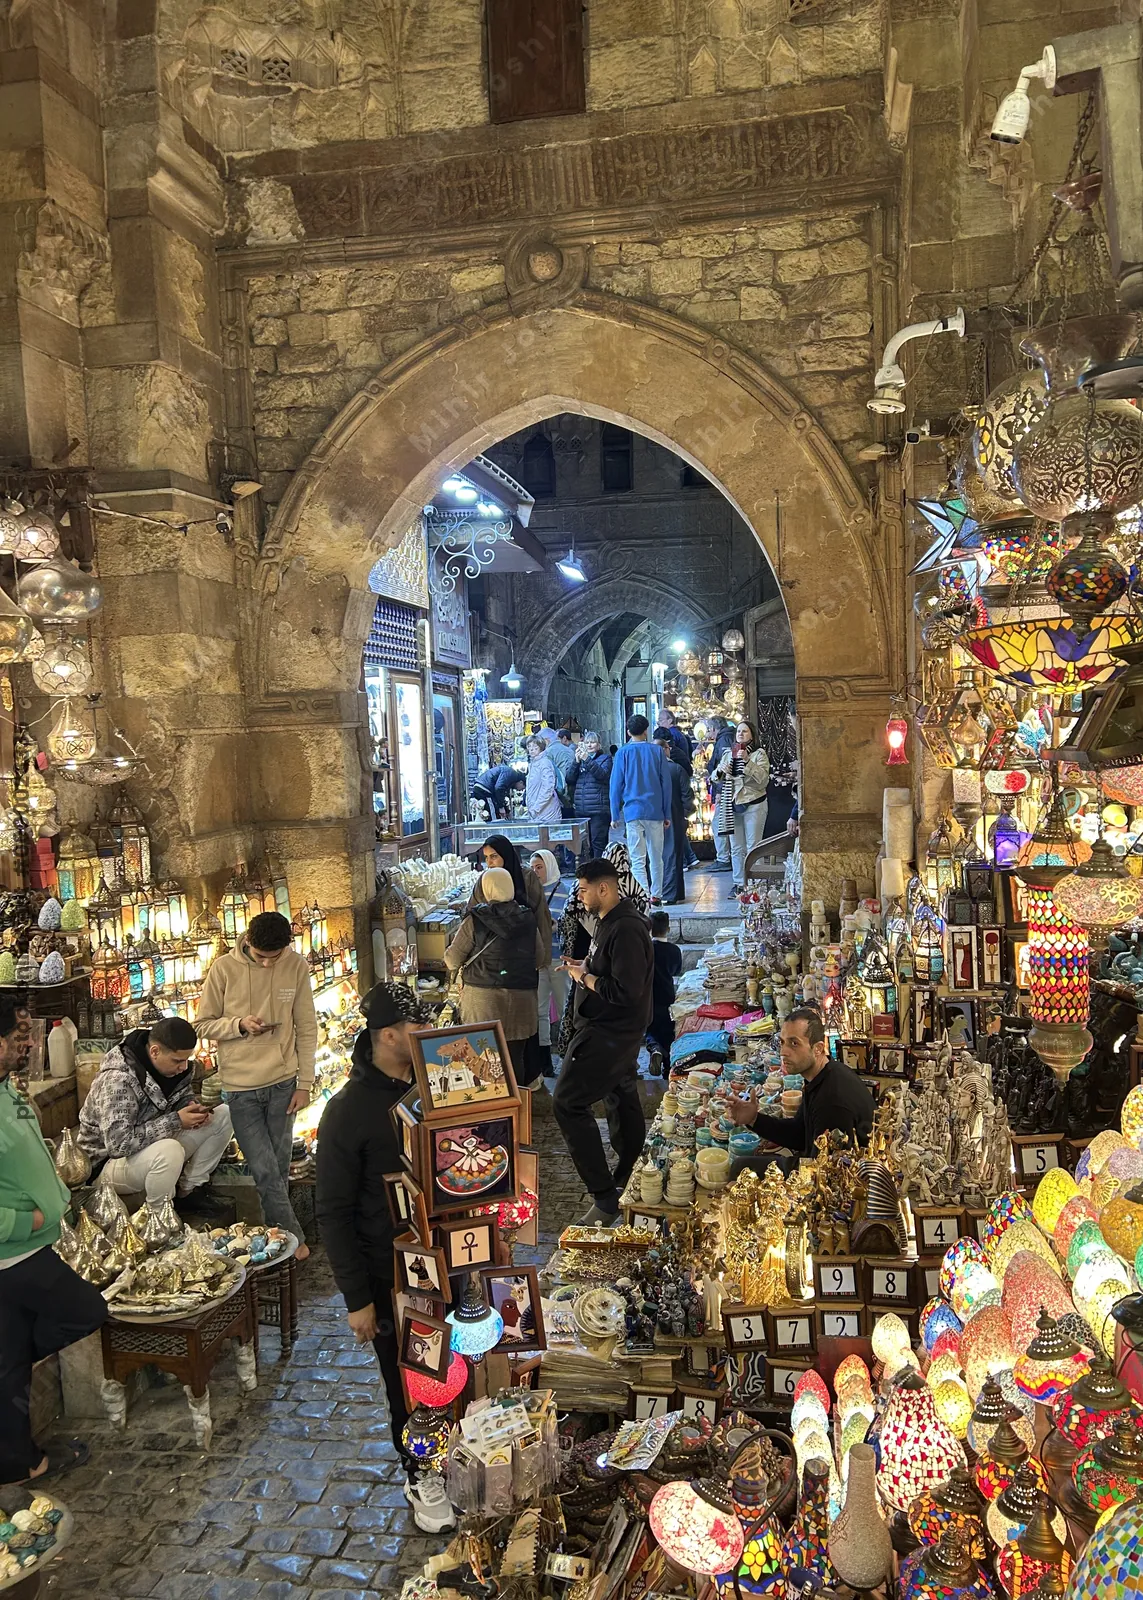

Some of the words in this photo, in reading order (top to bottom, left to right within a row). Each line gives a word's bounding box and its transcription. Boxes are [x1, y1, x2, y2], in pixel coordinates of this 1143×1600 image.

[1036, 1149, 1046, 1171] 5
[934, 1220, 946, 1243] 4
[832, 1269, 843, 1291] 9
[885, 1272, 896, 1293] 8
[743, 1318, 754, 1340] 3
[788, 1321, 799, 1343] 7
[835, 1316, 847, 1336] 2
[785, 1372, 796, 1393] 6
[647, 1398, 658, 1417] 7
[695, 1400, 705, 1417] 8
